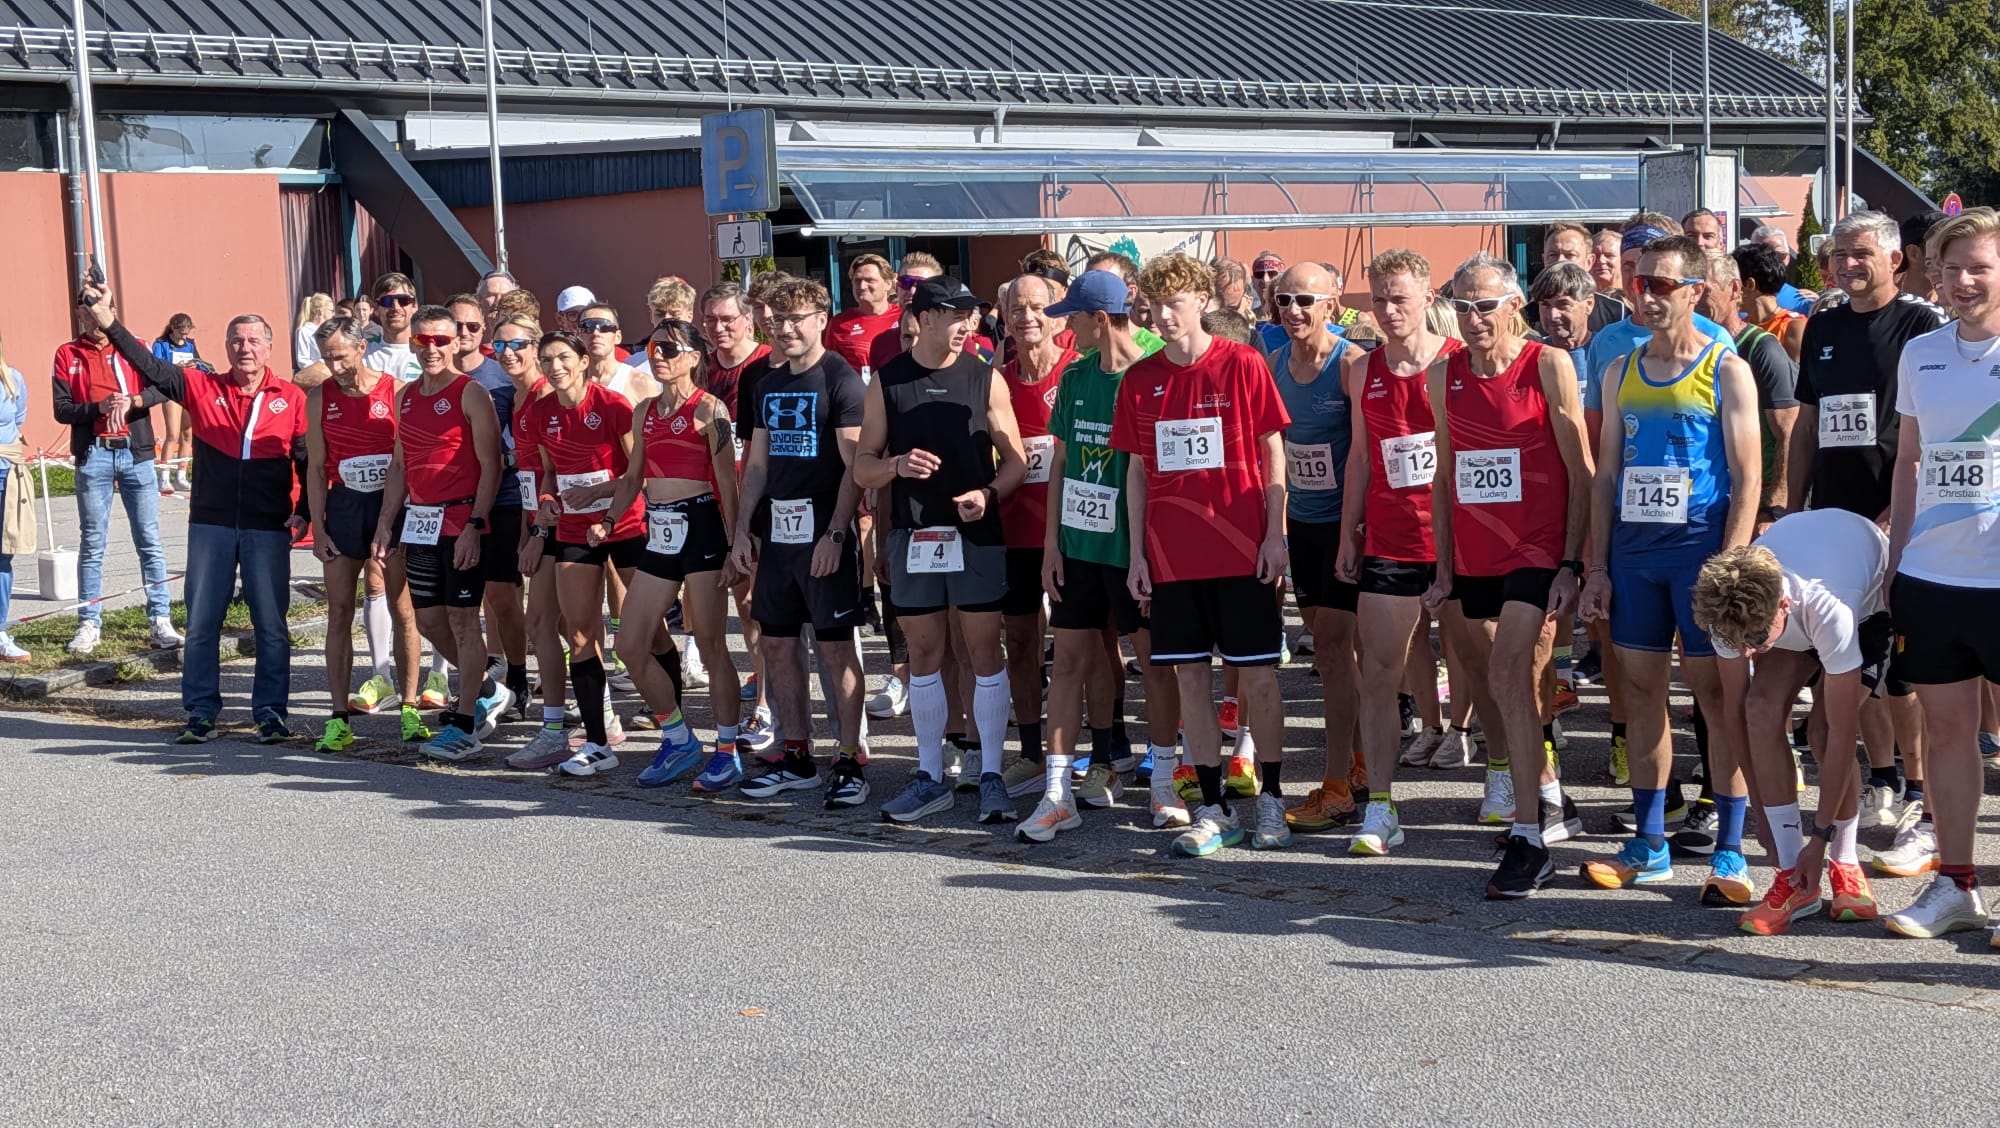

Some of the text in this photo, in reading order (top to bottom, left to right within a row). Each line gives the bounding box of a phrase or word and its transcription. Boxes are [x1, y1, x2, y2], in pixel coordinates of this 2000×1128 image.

[716, 127, 749, 200] P
[1830, 413, 1867, 432] 116
[1183, 437, 1209, 456] 13
[1295, 460, 1327, 478] 119
[1408, 451, 1435, 471] 12
[357, 467, 387, 483] 159
[1473, 468, 1513, 488] 203
[1937, 464, 1984, 487] 148
[1637, 486, 1680, 508] 145
[1938, 488, 1981, 498] Christian
[1076, 499, 1110, 521] 421
[1640, 508, 1675, 518] Michael
[415, 519, 438, 535] 249
[783, 514, 803, 532] 17
[663, 527, 673, 543] 9
[933, 542, 945, 560] 4
